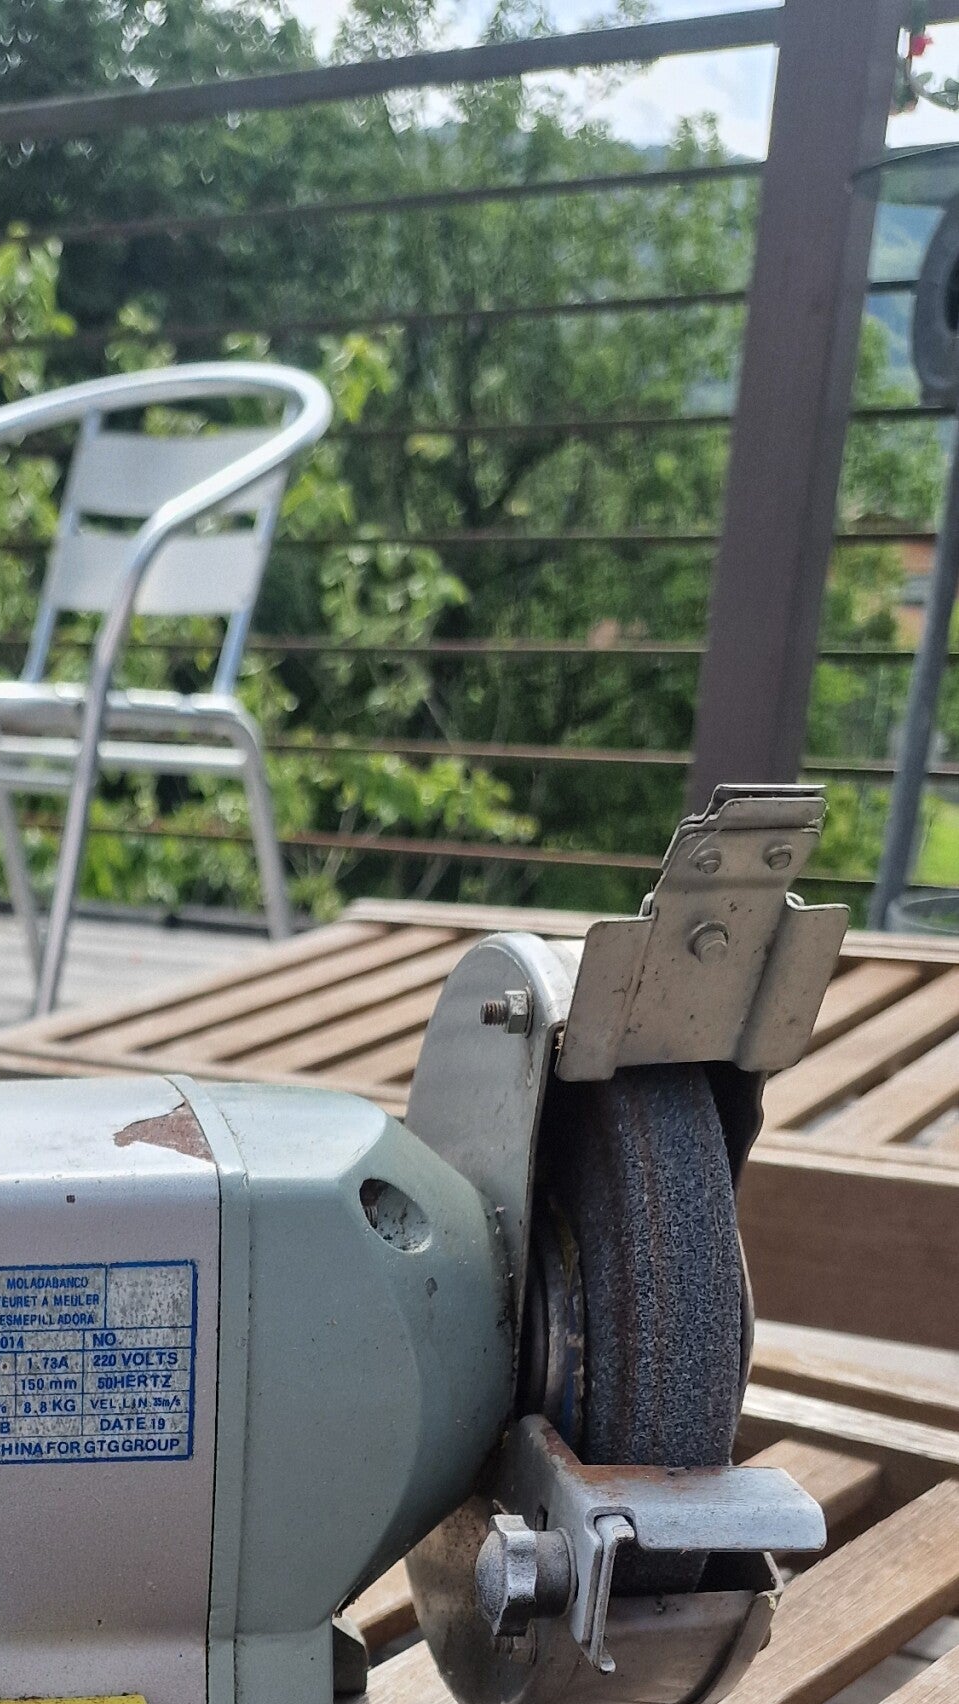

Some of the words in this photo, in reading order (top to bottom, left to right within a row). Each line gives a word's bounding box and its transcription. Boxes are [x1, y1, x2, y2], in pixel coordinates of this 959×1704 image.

[41, 1295, 49, 1307] A
[93, 1354, 117, 1367] 220
[121, 1352, 178, 1366] VOLTS
[21, 1378, 44, 1391] 150
[49, 1378, 77, 1390] mm
[52, 1399, 76, 1412] KG
[0, 1421, 11, 1434] B
[100, 1416, 146, 1431] DATE
[46, 1441, 80, 1455] FOR
